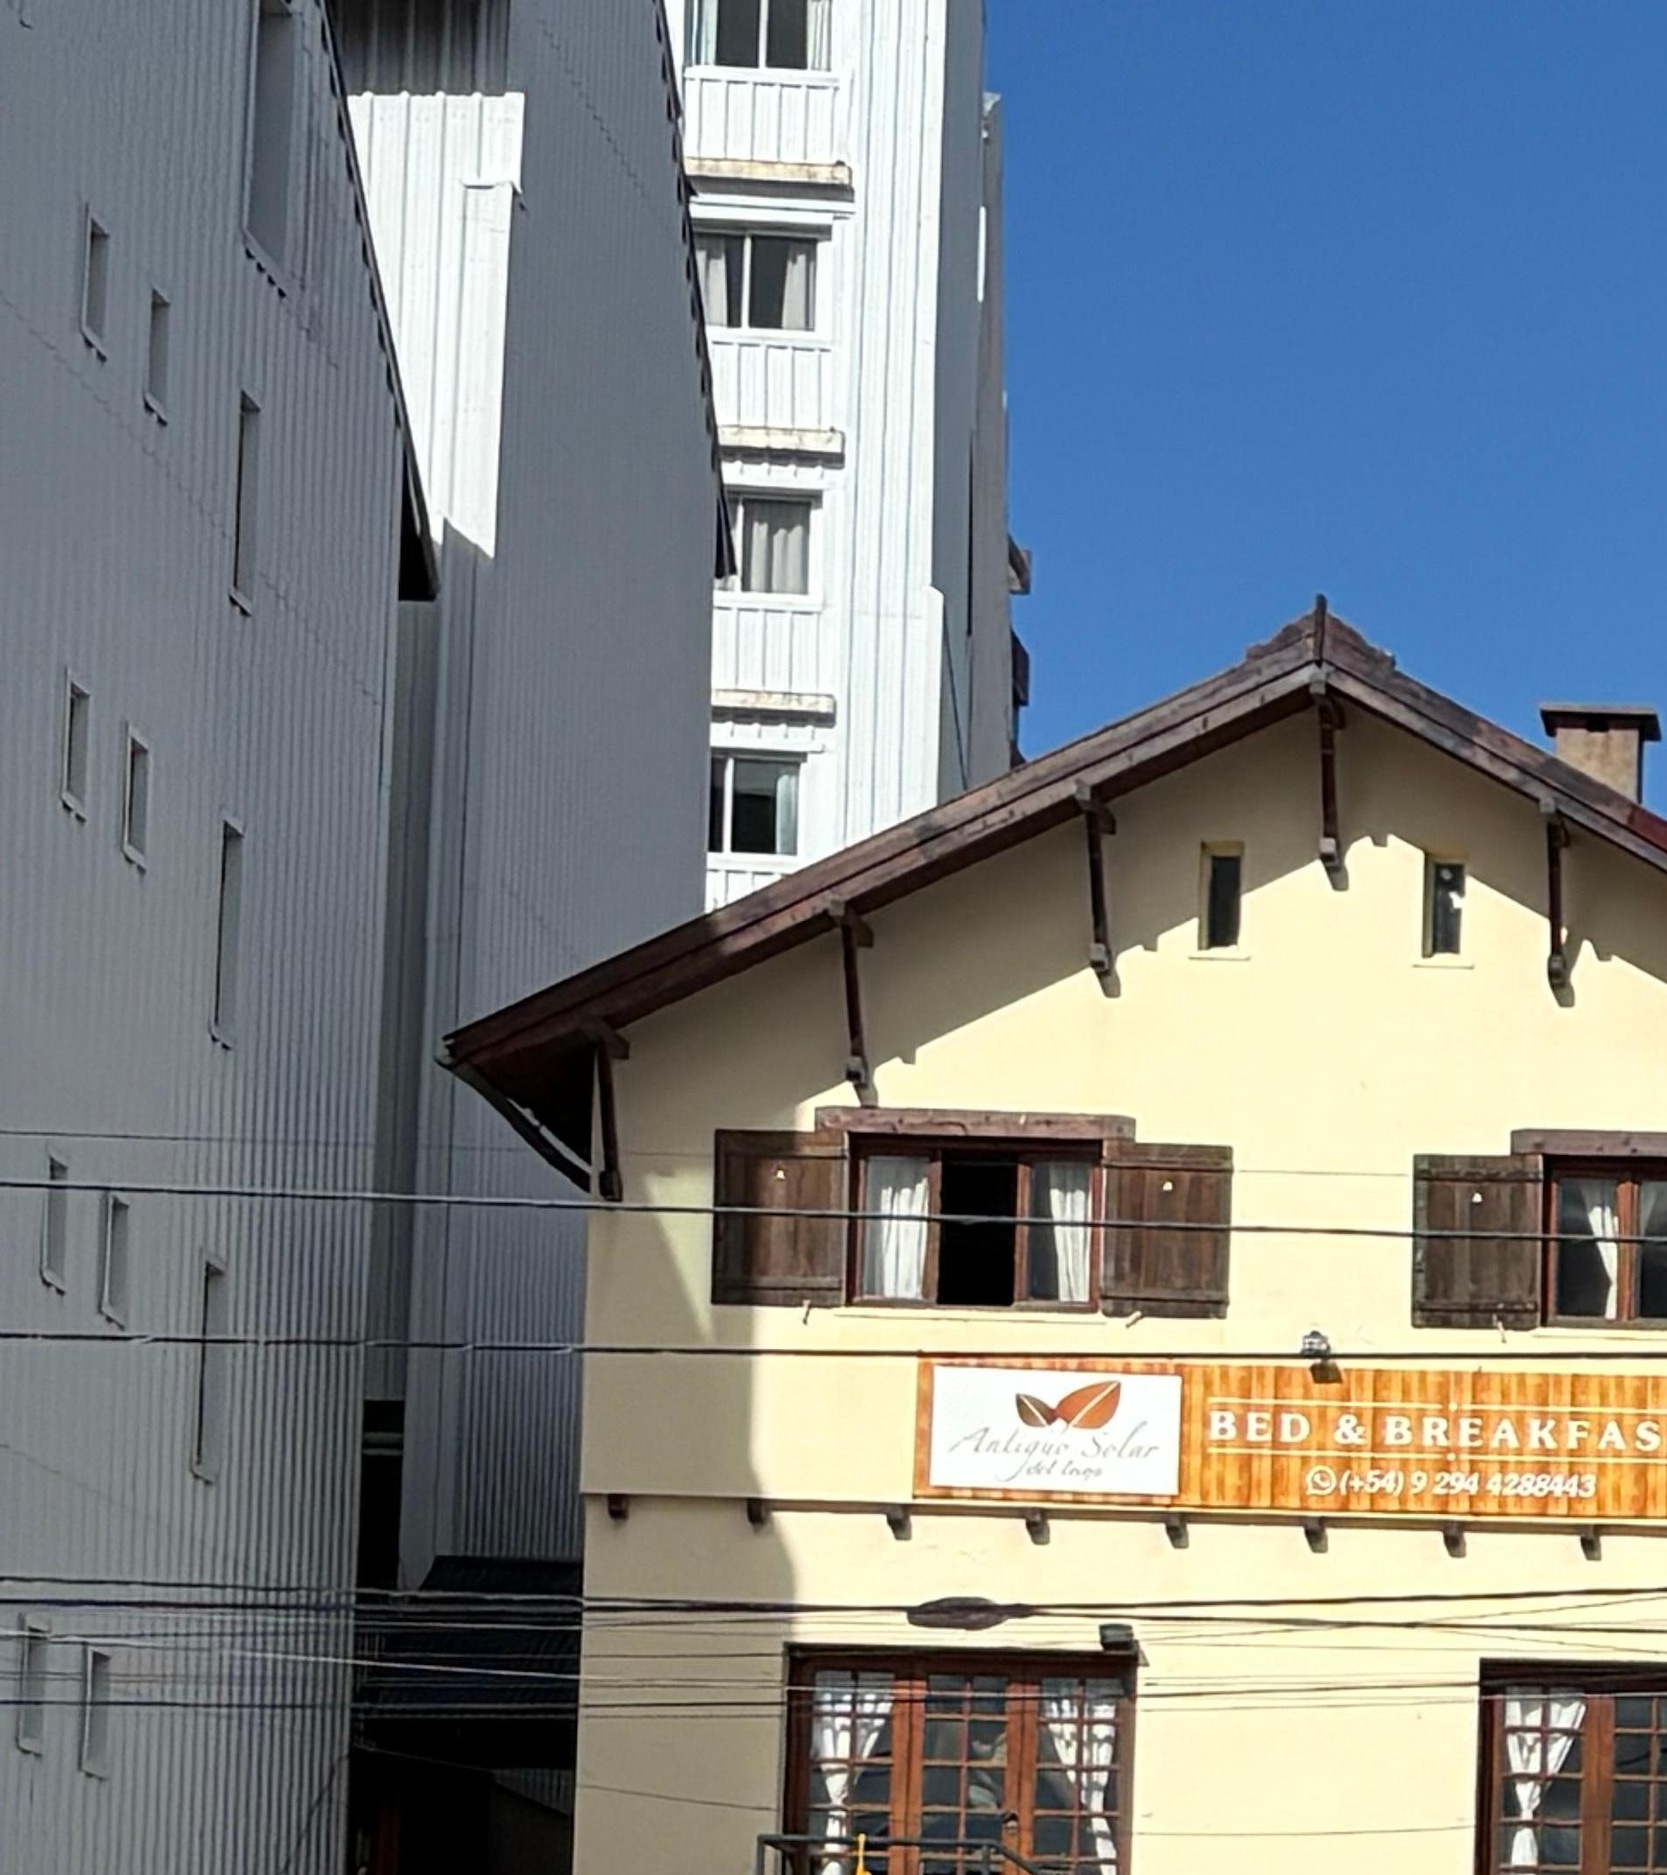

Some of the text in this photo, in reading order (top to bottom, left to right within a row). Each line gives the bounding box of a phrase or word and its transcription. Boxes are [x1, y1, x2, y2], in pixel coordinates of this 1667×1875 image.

[1209, 1411, 1310, 1443] BED
[1333, 1413, 1368, 1445] &
[1339, 1468, 1597, 1499] (+54) 9 294 4288443
